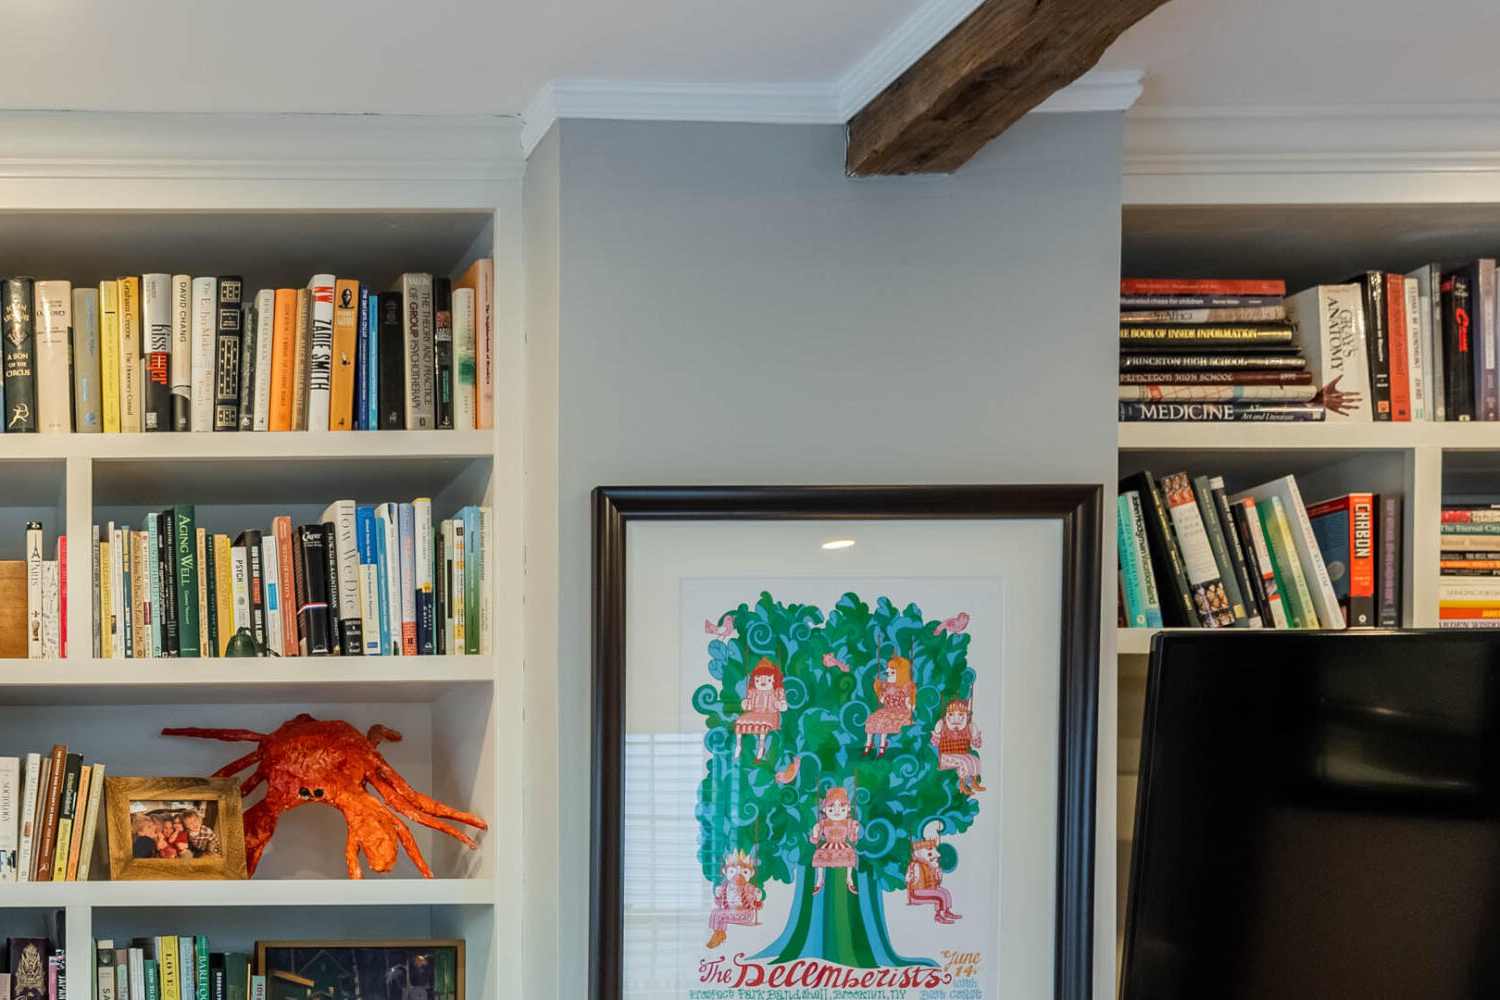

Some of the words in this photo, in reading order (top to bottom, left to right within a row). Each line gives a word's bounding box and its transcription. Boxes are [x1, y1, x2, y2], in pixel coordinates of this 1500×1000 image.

[124, 280, 132, 312] Graham
[314, 286, 333, 303] NW
[409, 288, 417, 301] OF
[312, 320, 332, 350] ZADIE
[409, 302, 419, 337] GROUP
[422, 311, 430, 342] THEORY
[1130, 329, 1155, 338] BOOK
[1155, 329, 1167, 338] OF
[1168, 329, 1195, 338] INSIDE
[1198, 329, 1257, 338] INFORMATION
[1327, 296, 1344, 371] ANATOMY
[1339, 308, 1356, 357] GRAY'S
[423, 345, 431, 362] AND
[311, 354, 330, 391] SMITH
[410, 340, 420, 409] PSYCHOTHERAPY
[424, 365, 432, 405] PRACTICE
[1139, 404, 1234, 419] MEDICINE
[179, 514, 191, 553] AGING
[340, 506, 354, 541] How
[1354, 504, 1370, 558] CHABON
[31, 560, 40, 586] PARIS
[181, 554, 193, 586] WELL
[343, 549, 357, 574] We
[345, 579, 357, 609] Die
[699, 956, 732, 983] The
[730, 952, 952, 989] Decemberists
[940, 950, 981, 972] June
